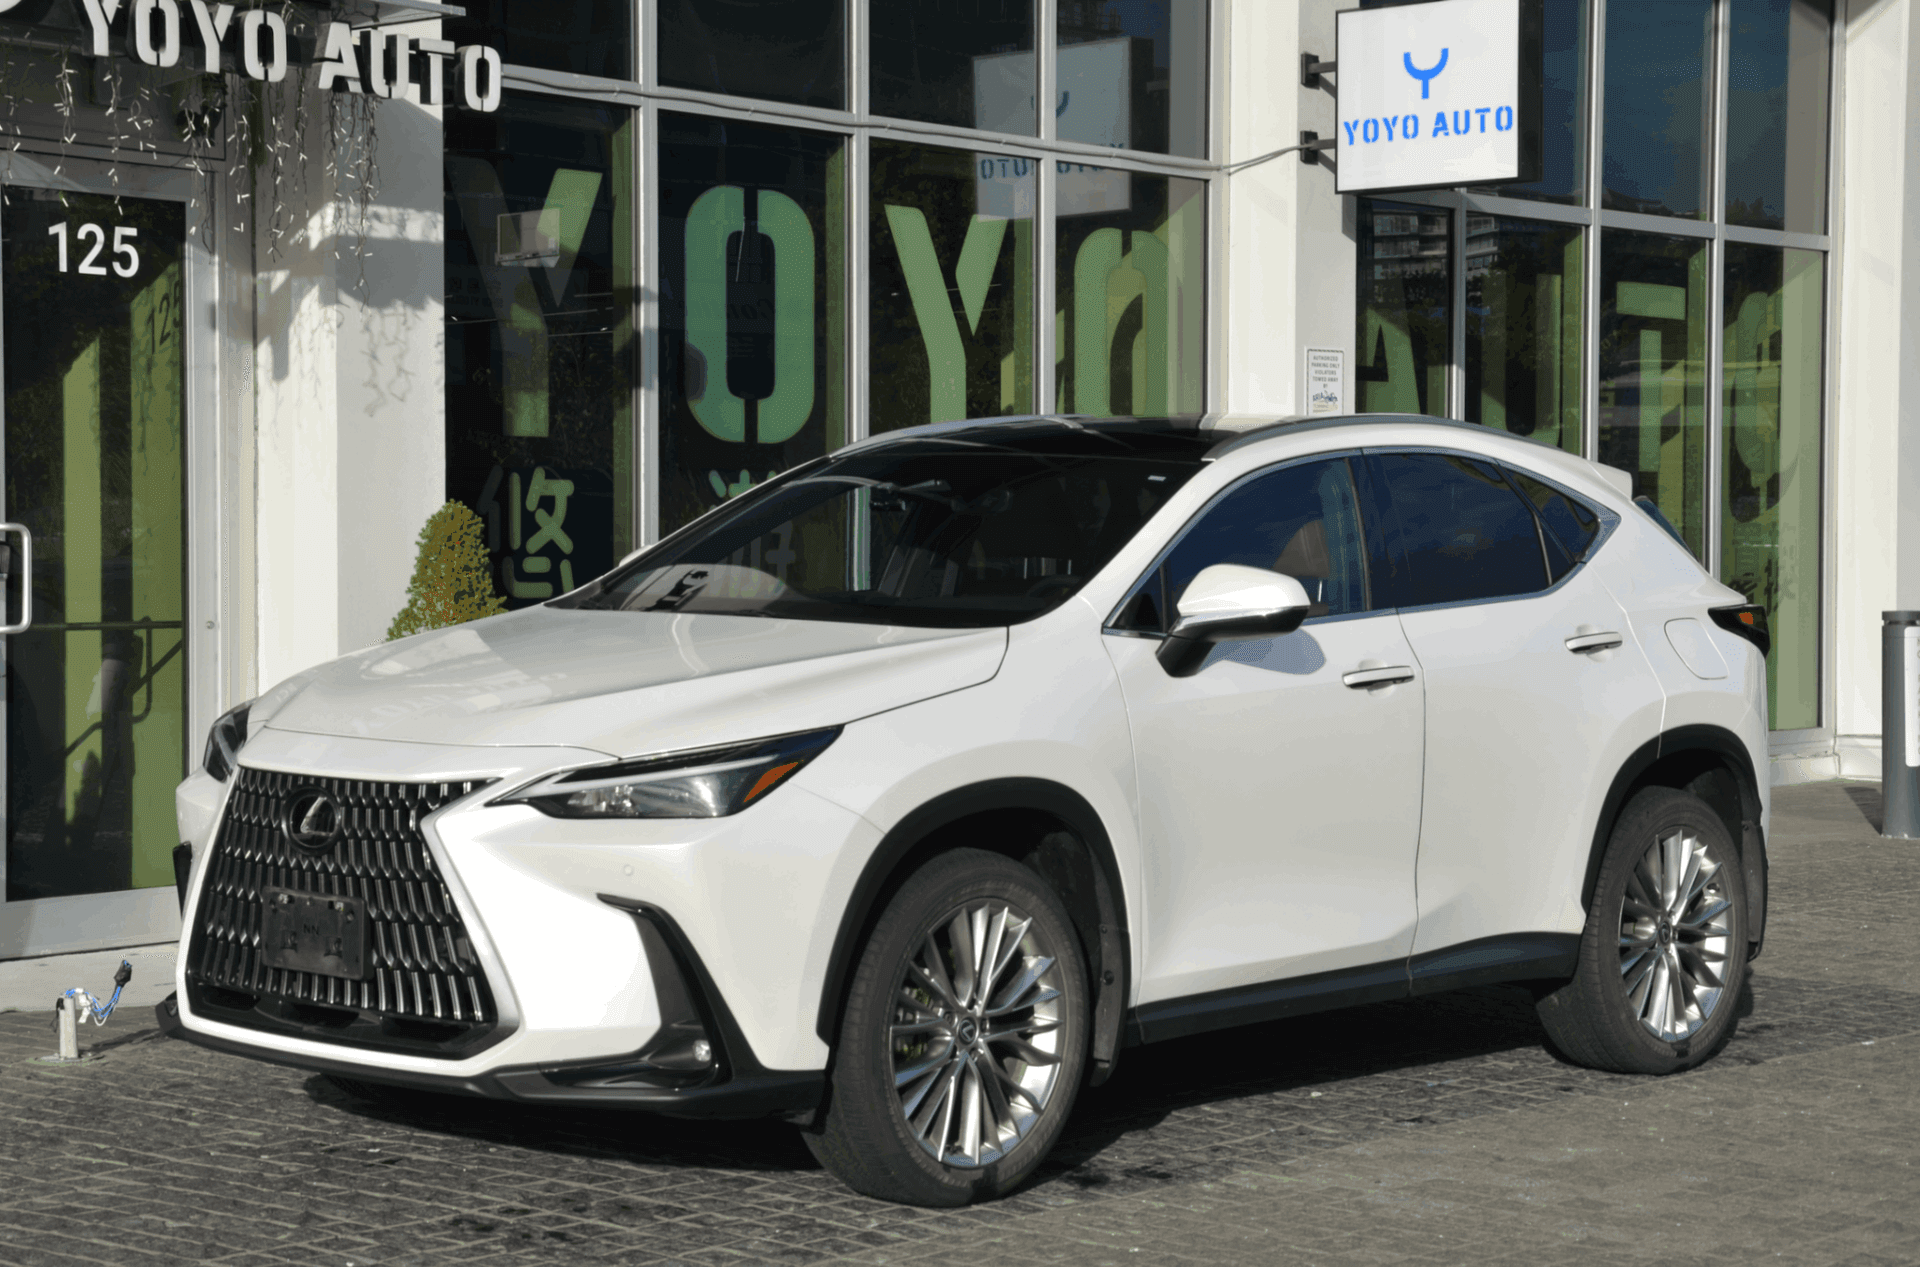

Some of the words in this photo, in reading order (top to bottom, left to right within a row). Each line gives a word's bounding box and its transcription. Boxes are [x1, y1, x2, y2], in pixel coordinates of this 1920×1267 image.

[82, 0, 288, 83] YOYO
[318, 21, 502, 113] AUTO
[1343, 114, 1420, 146] YOYO
[1432, 105, 1513, 138] AUTO
[48, 221, 140, 278] 125
